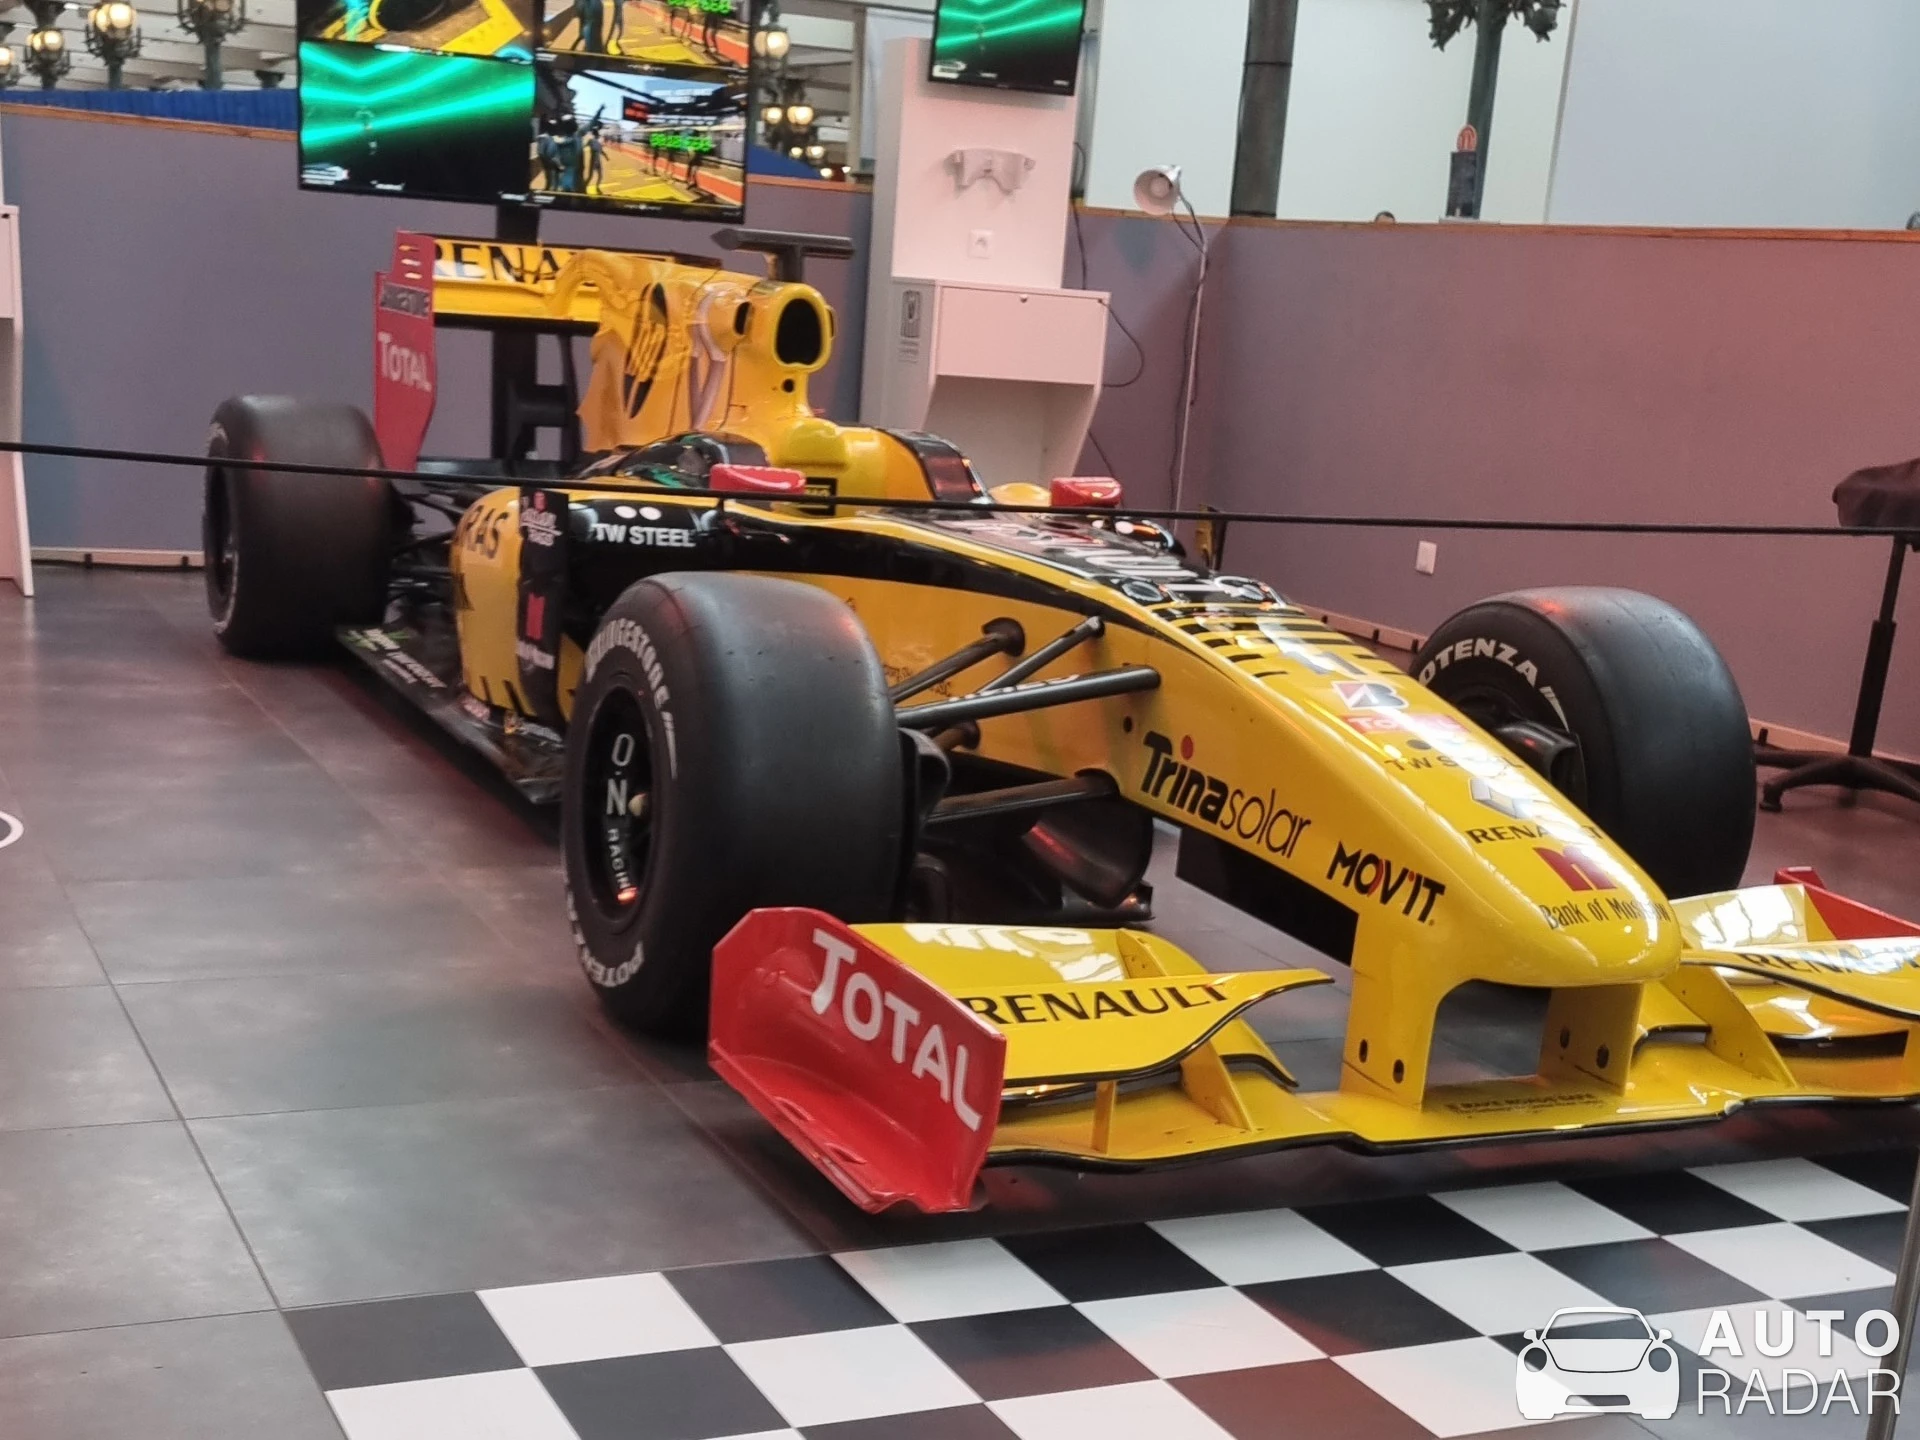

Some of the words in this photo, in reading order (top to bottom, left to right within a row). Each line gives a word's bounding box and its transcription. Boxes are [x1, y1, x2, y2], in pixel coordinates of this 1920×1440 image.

[434, 243, 563, 285] RENA
[378, 332, 432, 392] TOTAL
[593, 523, 627, 543] TW
[629, 526, 696, 547] STEEL
[1418, 638, 1539, 688] OTENZA
[1539, 901, 1589, 930] Bank
[1588, 898, 1611, 922] of
[956, 983, 1228, 1025] RENAULT
[811, 928, 982, 1133] TOTAL
